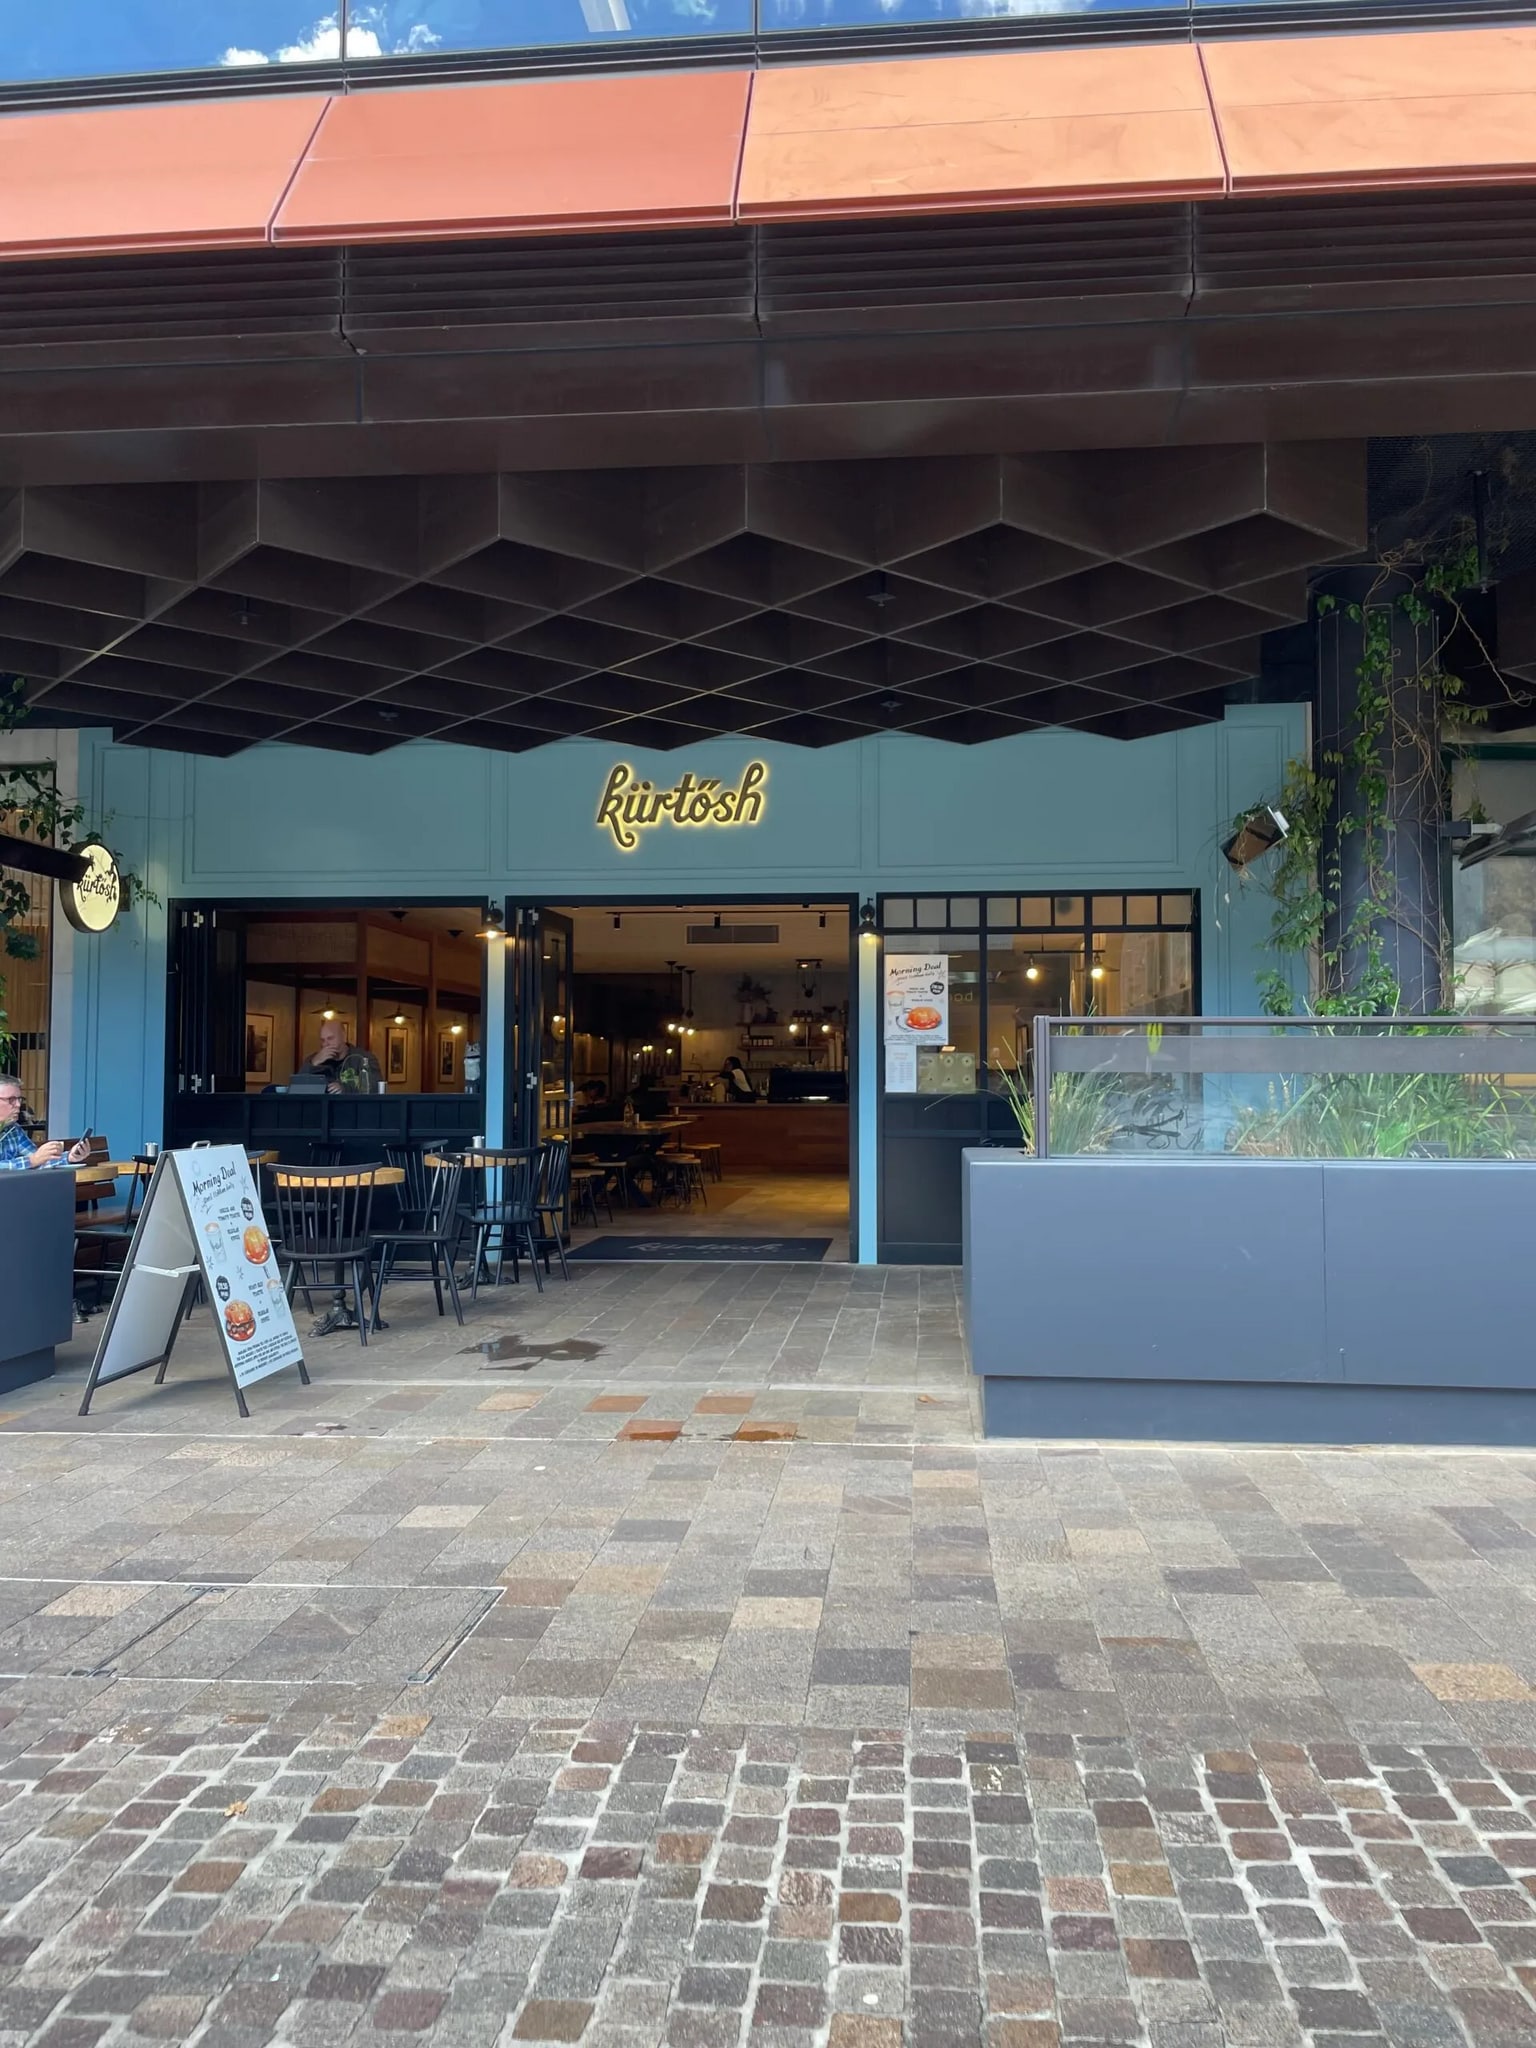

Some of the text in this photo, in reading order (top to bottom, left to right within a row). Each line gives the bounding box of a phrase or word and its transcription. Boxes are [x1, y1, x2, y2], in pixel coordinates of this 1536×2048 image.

[597, 762, 764, 848] kürtősh
[889, 965, 922, 977] Morning
[924, 961, 942, 971] Deal
[192, 1173, 222, 1197] Morning
[221, 1161, 237, 1180] Deal
